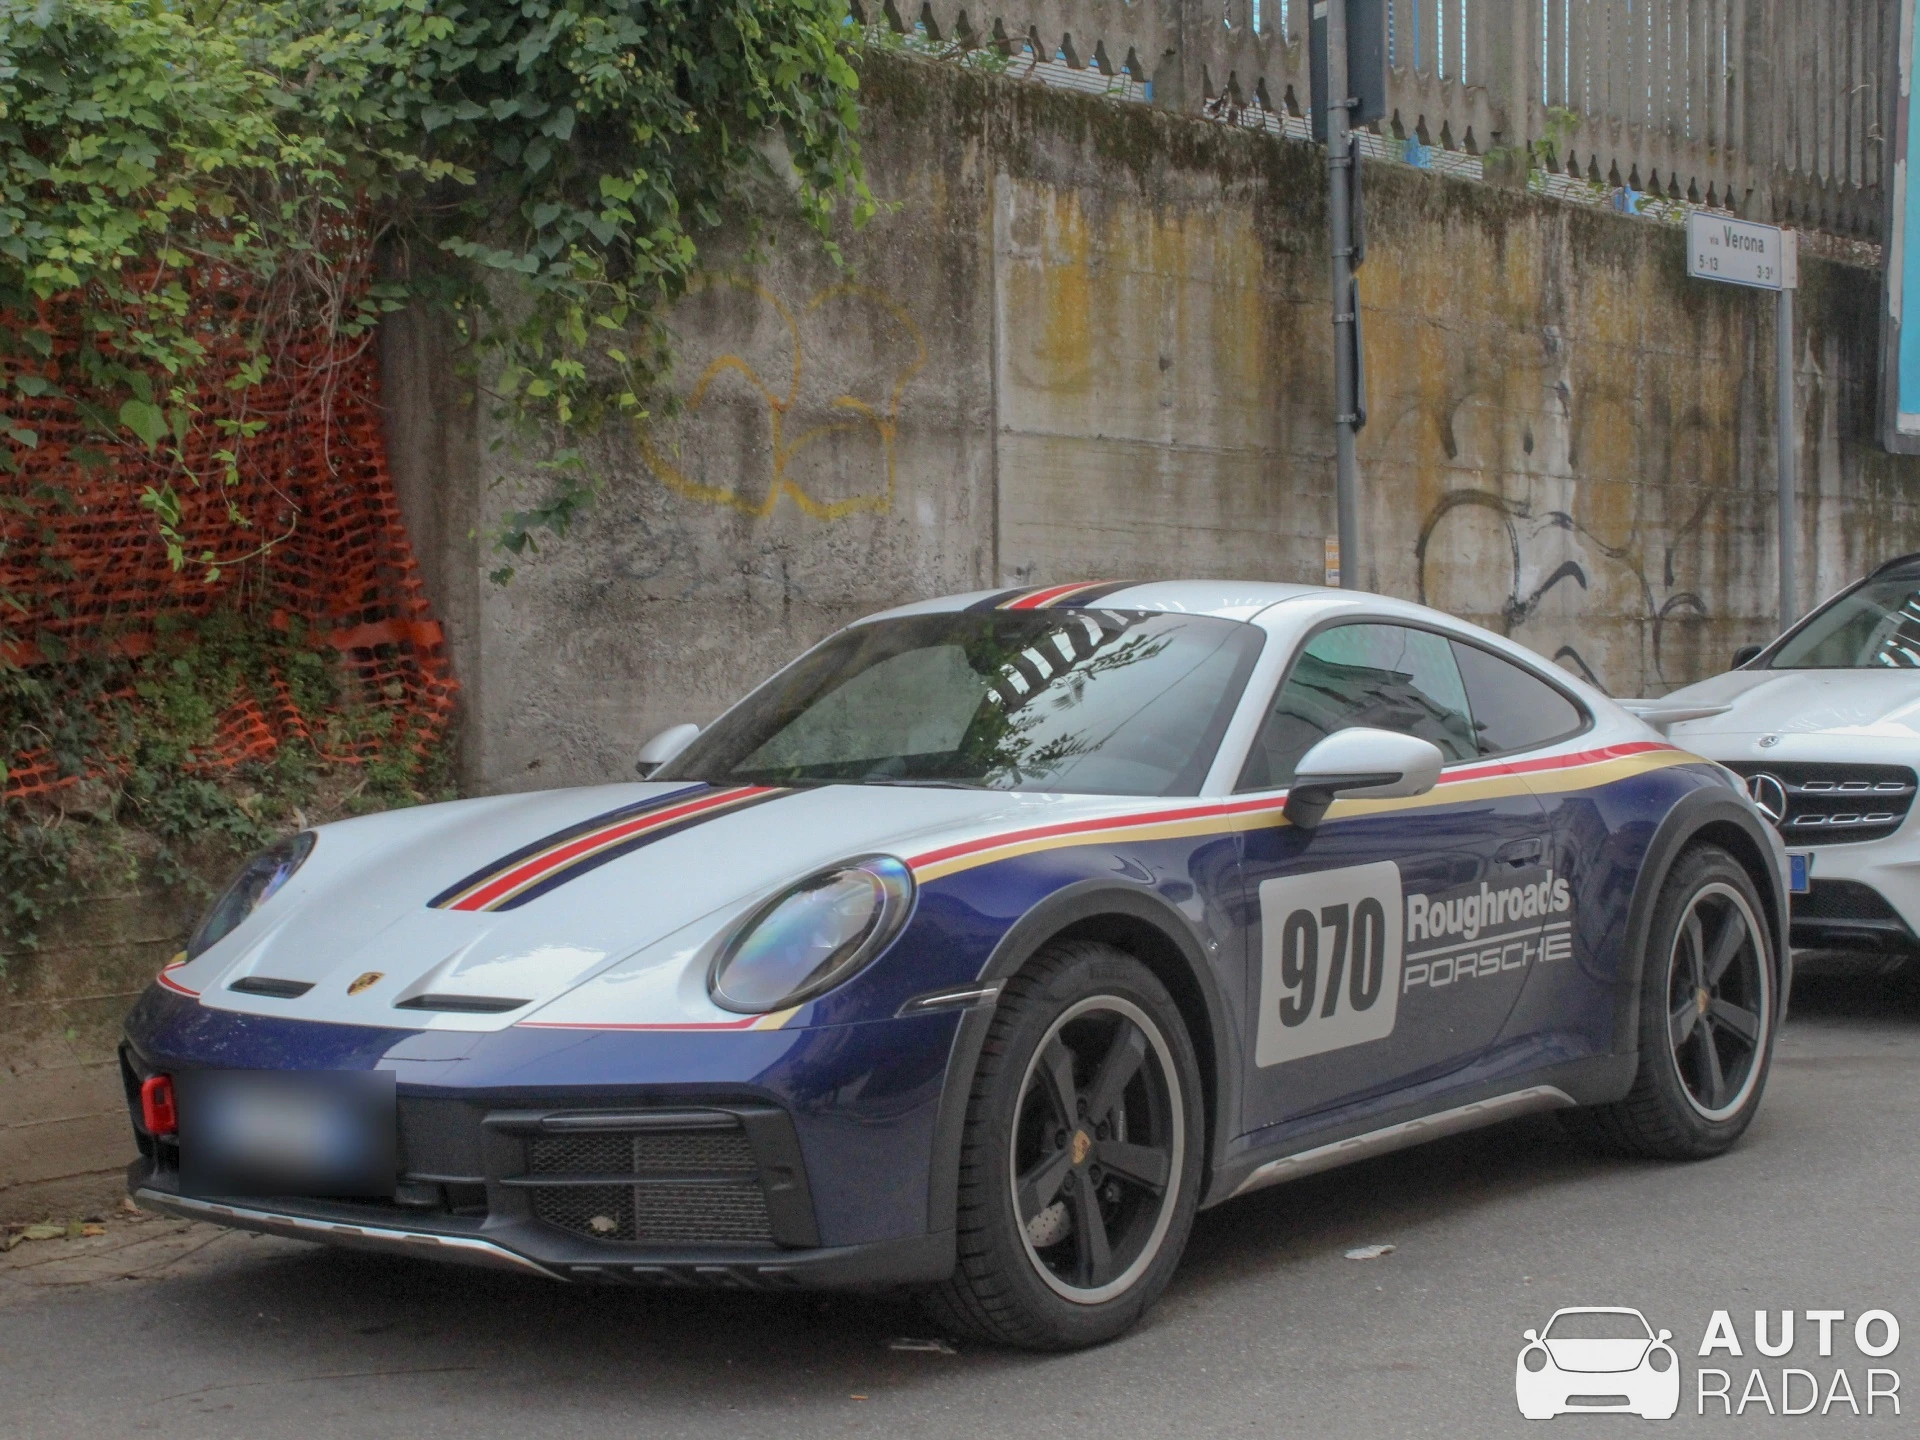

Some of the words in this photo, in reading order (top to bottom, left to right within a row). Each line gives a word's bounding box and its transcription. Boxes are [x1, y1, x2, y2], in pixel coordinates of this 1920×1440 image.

[1709, 234, 1719, 246] via
[1724, 226, 1764, 253] Verona
[1407, 869, 1570, 942] Roughroads
[1279, 897, 1385, 1028] 970
[1403, 932, 1572, 994] PORSCHE
